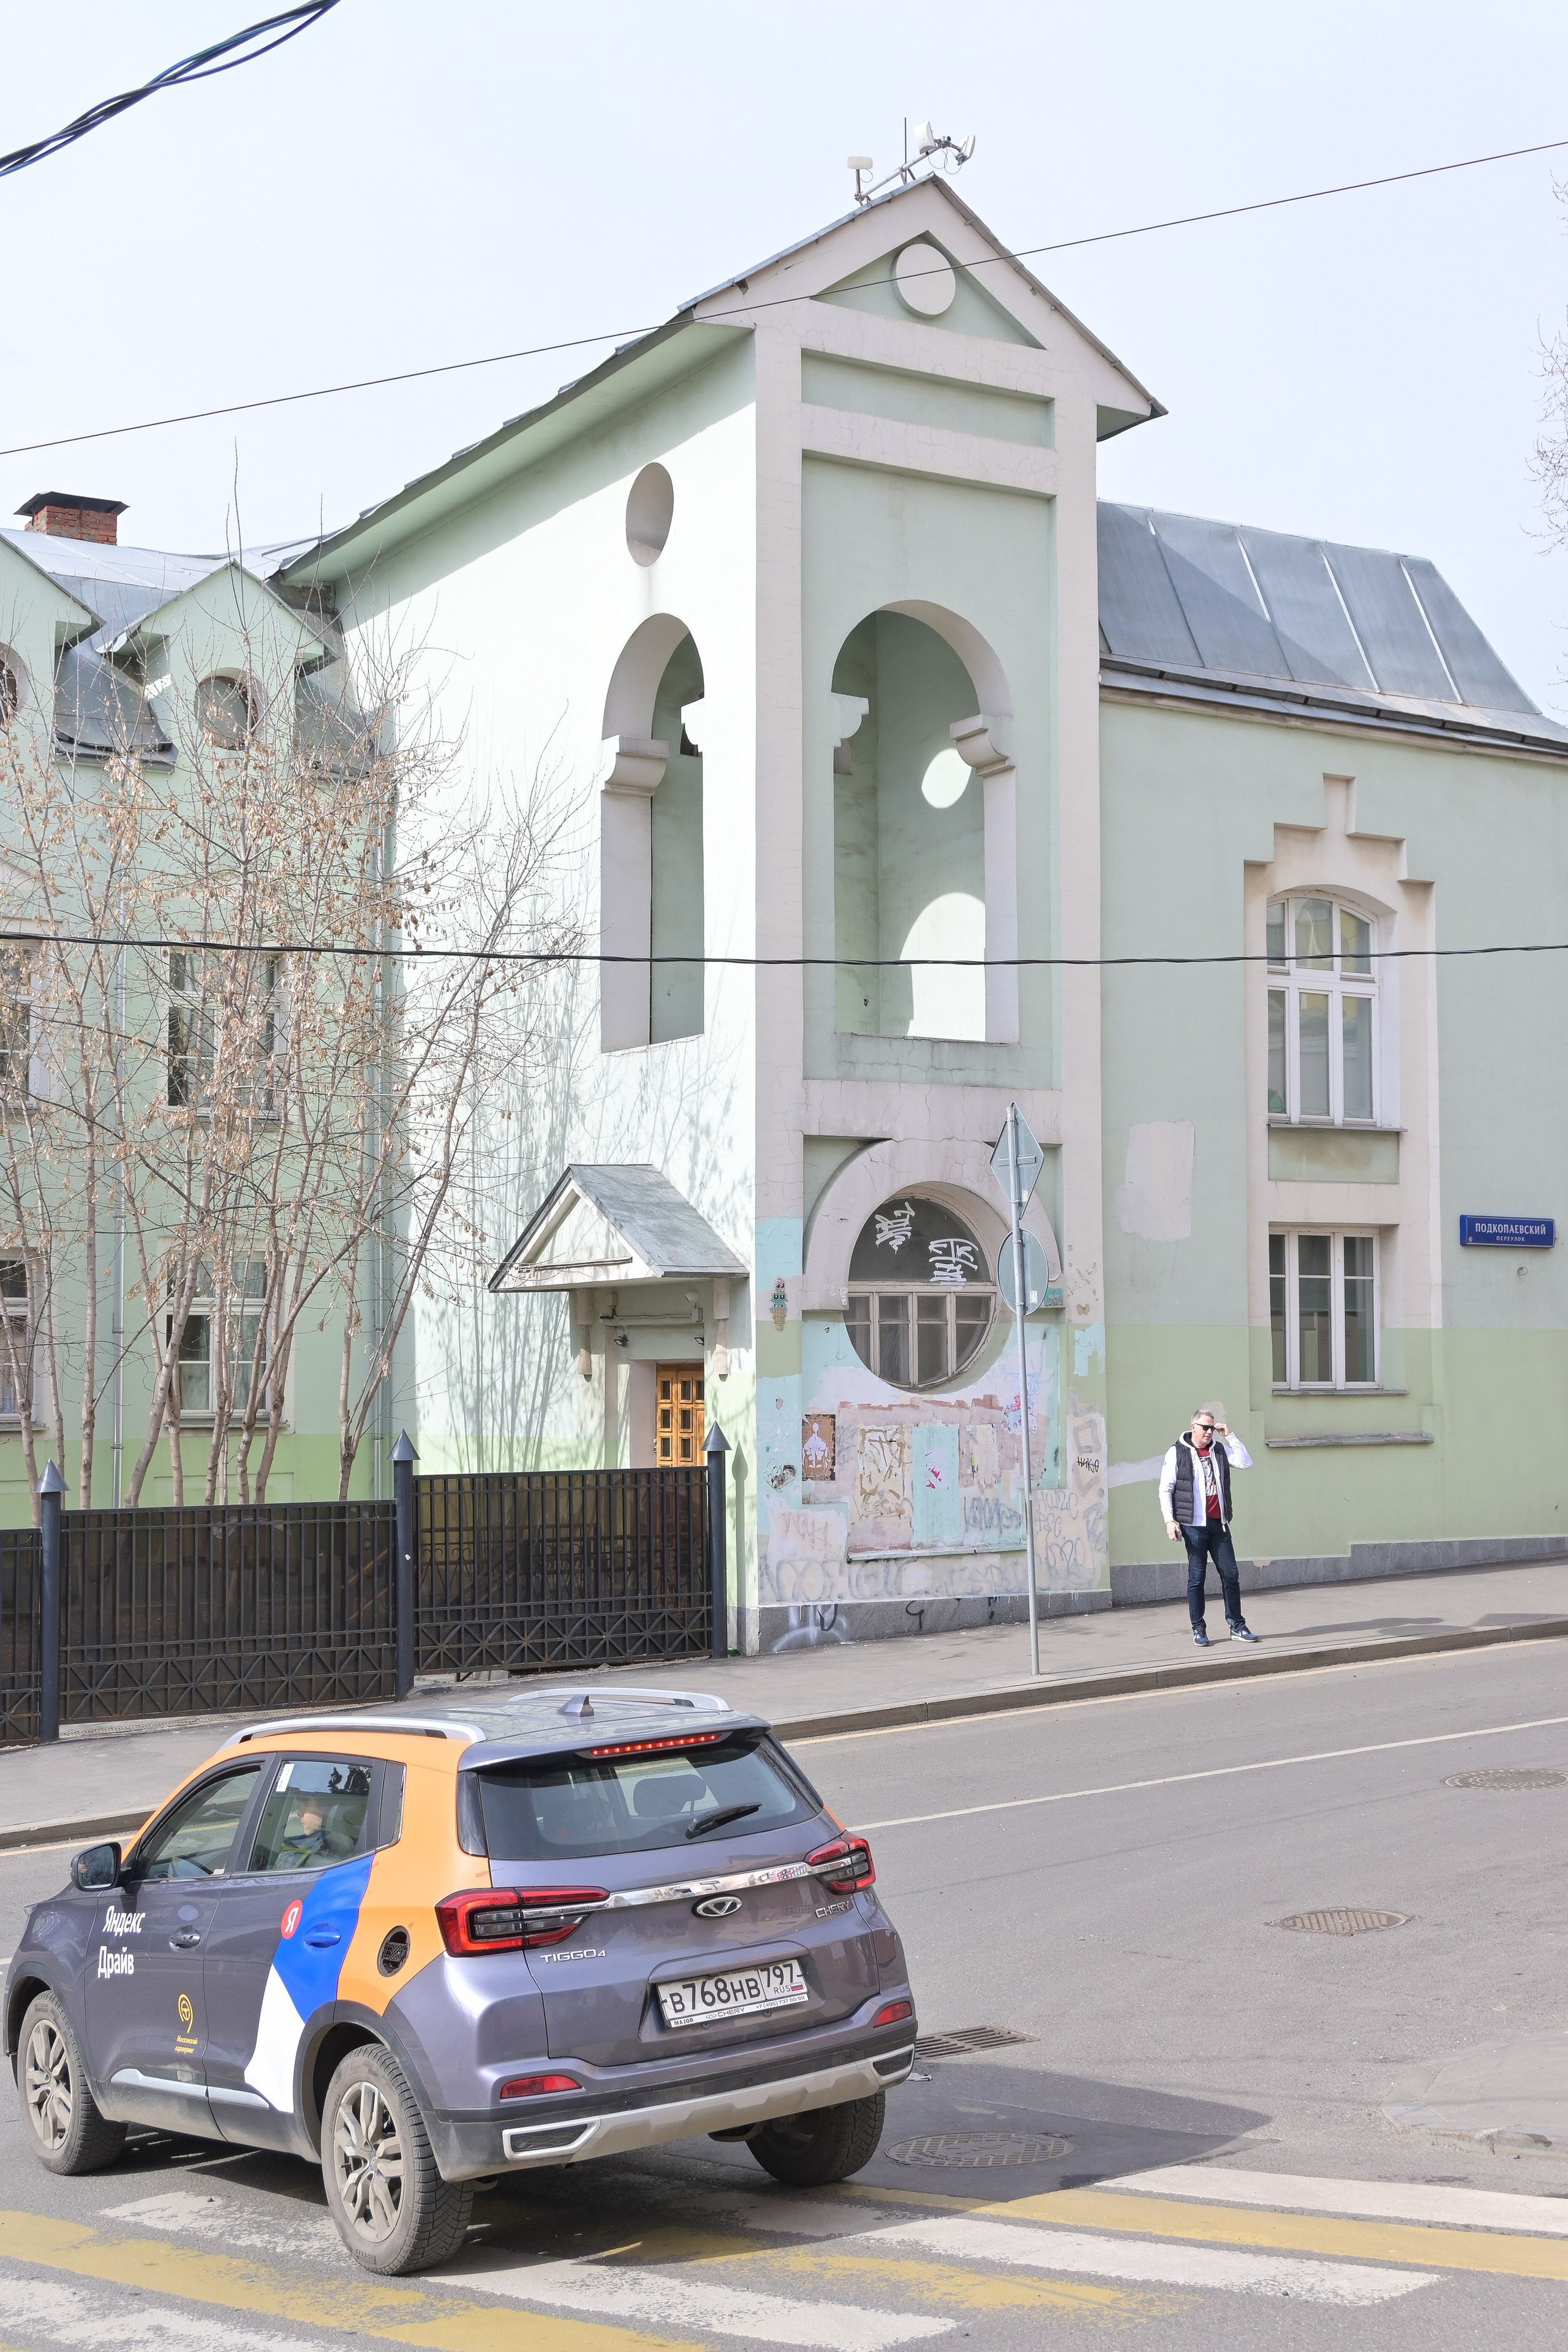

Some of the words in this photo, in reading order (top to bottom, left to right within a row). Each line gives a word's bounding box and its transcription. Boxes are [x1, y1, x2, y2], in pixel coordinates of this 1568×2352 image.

[1475, 1223, 1546, 1235] ПОДКОПАЕВСКИЙ
[815, 1901, 849, 1918] CHERY
[102, 1905, 146, 1937] Яндекс
[284, 1907, 299, 1932] Я
[97, 1945, 135, 1979] Драйв
[760, 1962, 794, 1988] 797
[774, 1985, 791, 1995] RUS
[717, 2007, 745, 2018] CHERY
[763, 2000, 778, 2009] (495)
[674, 2018, 694, 2026] MAJOR
[356, 2248, 377, 2265] PIRELLI
